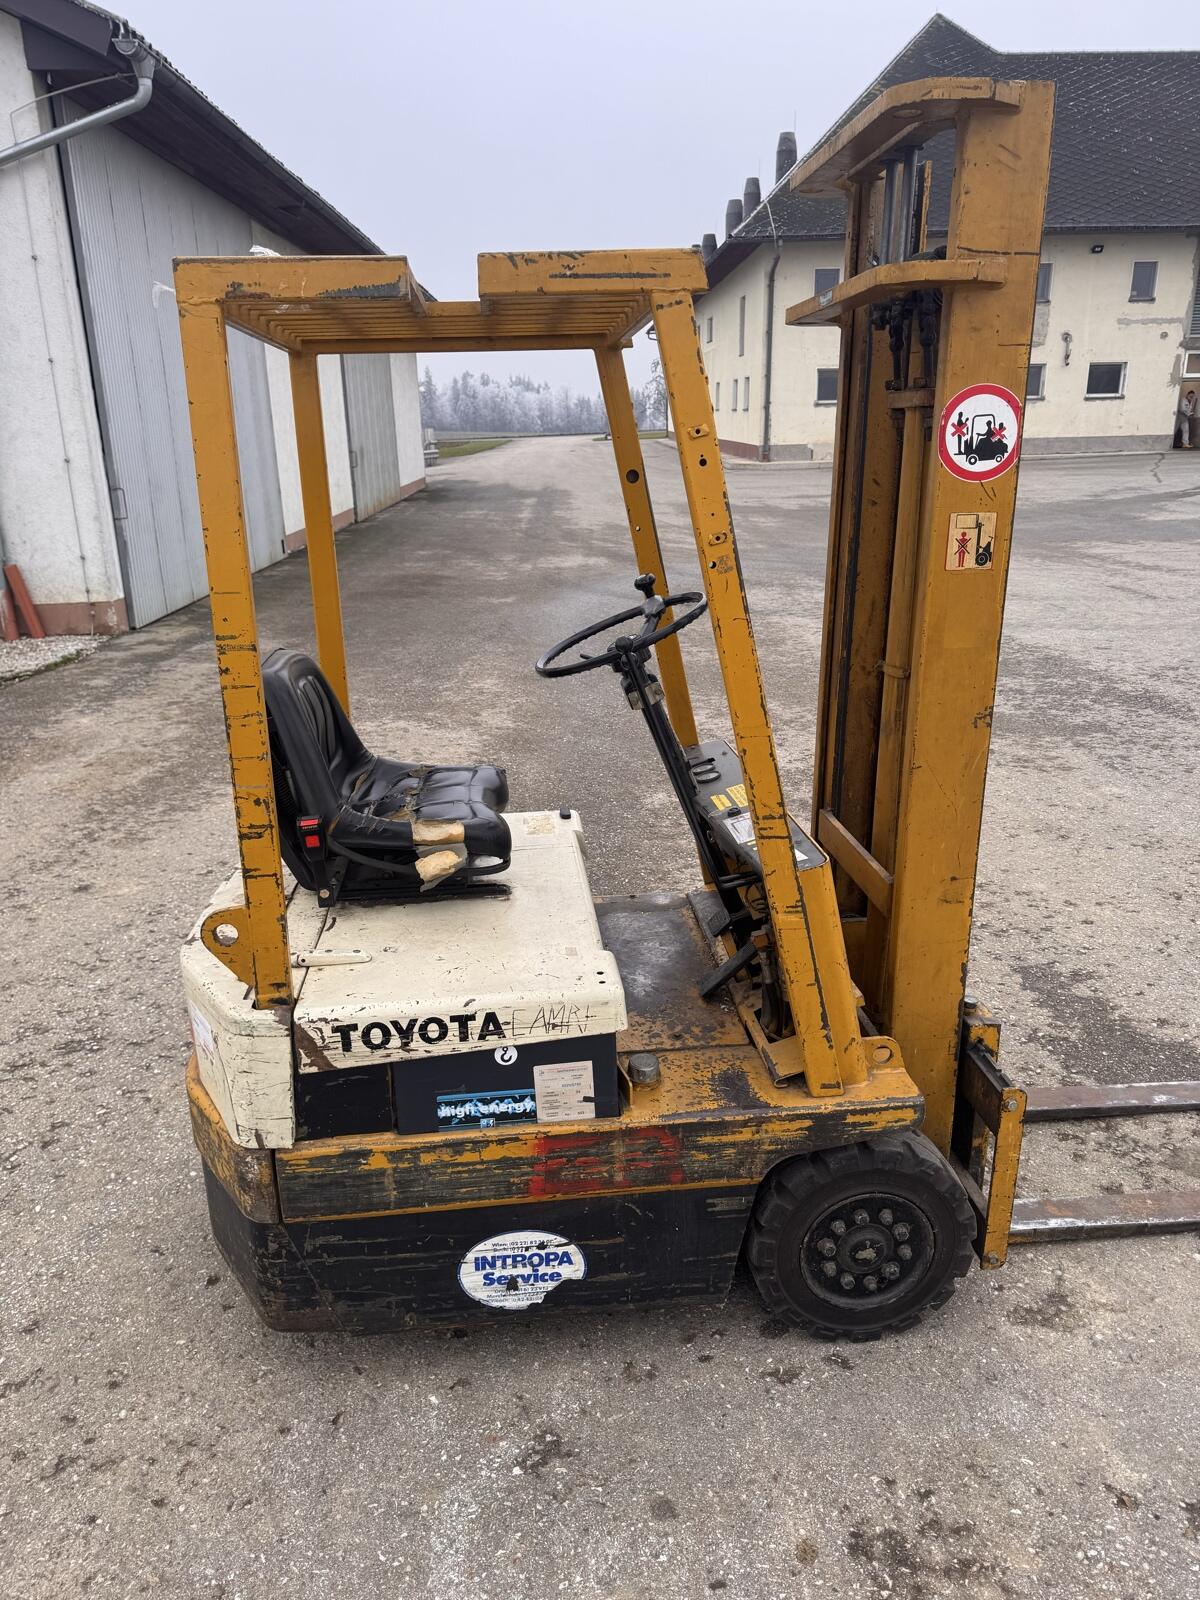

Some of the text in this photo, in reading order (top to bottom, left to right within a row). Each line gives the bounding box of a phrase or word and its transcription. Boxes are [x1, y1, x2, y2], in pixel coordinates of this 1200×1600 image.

[331, 1012, 506, 1053] TOYOTA
[474, 1251, 574, 1272] INTROPA
[483, 1269, 562, 1286] Service
